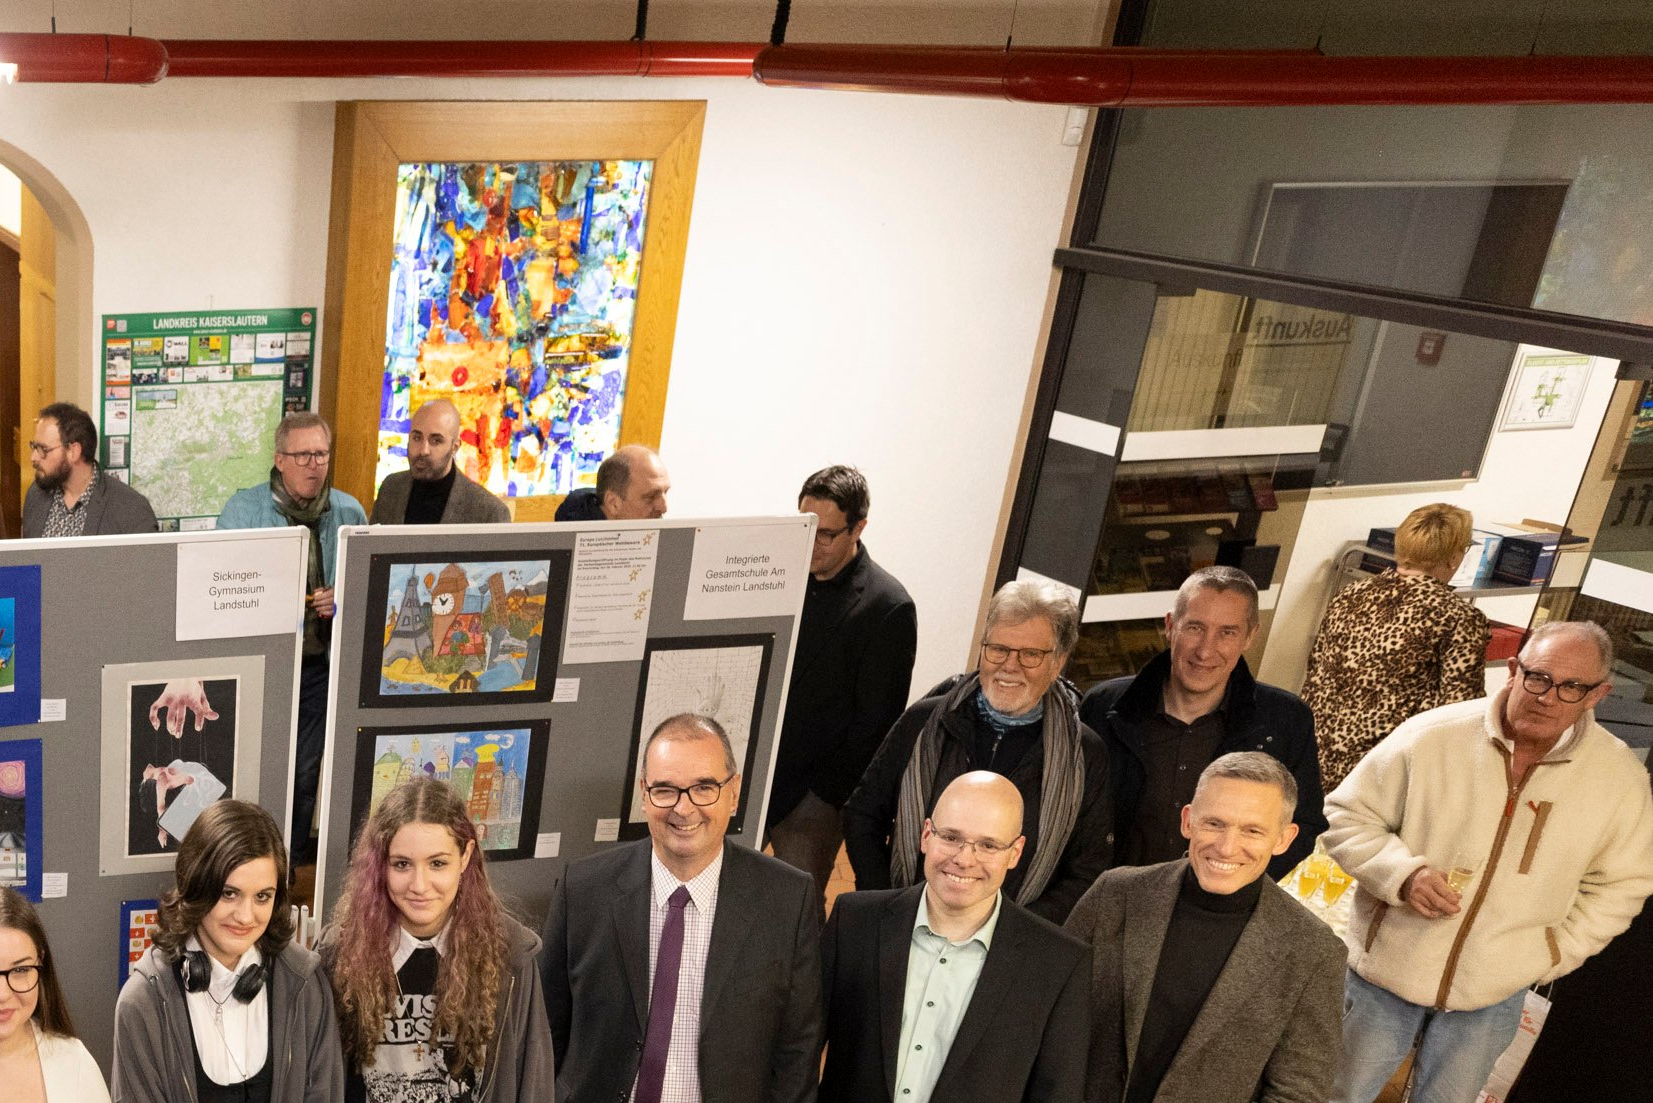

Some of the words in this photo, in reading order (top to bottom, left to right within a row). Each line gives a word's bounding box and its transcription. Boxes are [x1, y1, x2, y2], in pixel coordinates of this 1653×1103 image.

[153, 317, 197, 329] LANDKREIS
[199, 315, 268, 328] KAISERSLAUTERN
[726, 554, 770, 566] Integrierte
[213, 571, 261, 582] Sickingen-
[706, 568, 768, 579] Gesamtschule
[771, 567, 785, 576] Am
[209, 585, 265, 598] Gymnasium
[702, 583, 740, 593] Nanstein
[743, 581, 785, 591] Landstuhl
[214, 599, 259, 610] Landstuhl
[384, 994, 437, 1019] VIS
